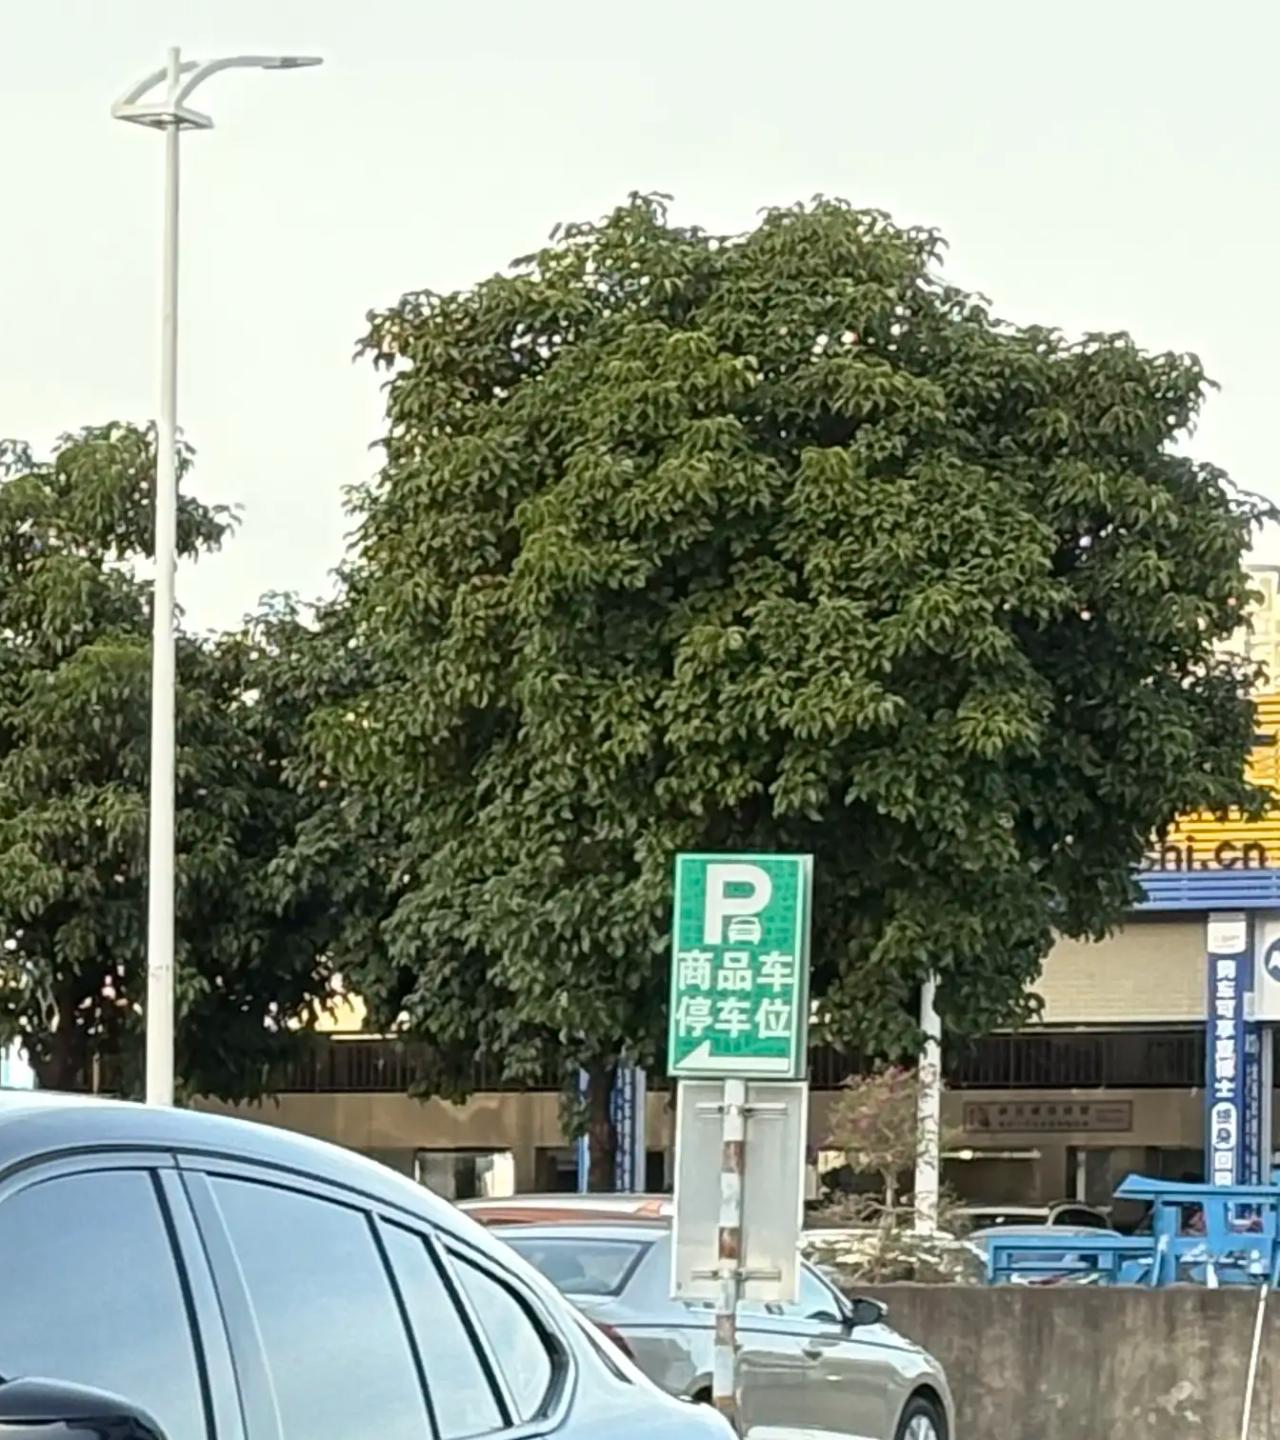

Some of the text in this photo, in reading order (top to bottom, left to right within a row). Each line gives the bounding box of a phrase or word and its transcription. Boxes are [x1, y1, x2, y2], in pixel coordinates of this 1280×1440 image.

[704, 864, 773, 945] P
[677, 949, 794, 991] 商品车
[675, 996, 792, 1039] 停车位
